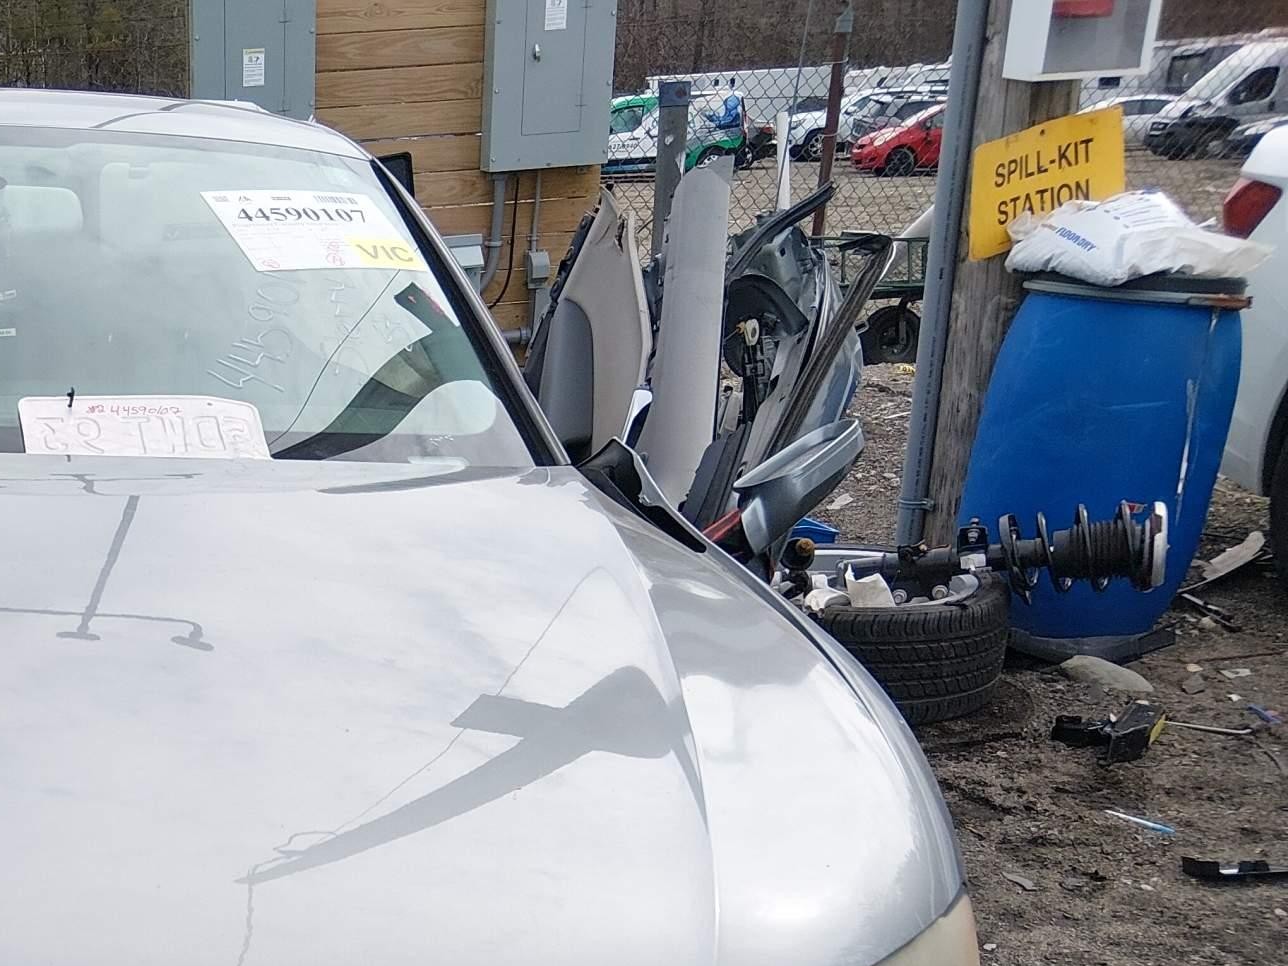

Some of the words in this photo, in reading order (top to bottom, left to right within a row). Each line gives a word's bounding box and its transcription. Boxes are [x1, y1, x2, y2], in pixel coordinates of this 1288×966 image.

[994, 137, 1094, 188] SPILL-KIT
[997, 178, 1091, 226] STATION
[237, 207, 366, 223] 44590107
[355, 243, 414, 262] VIC
[111, 404, 183, 416] 44590107
